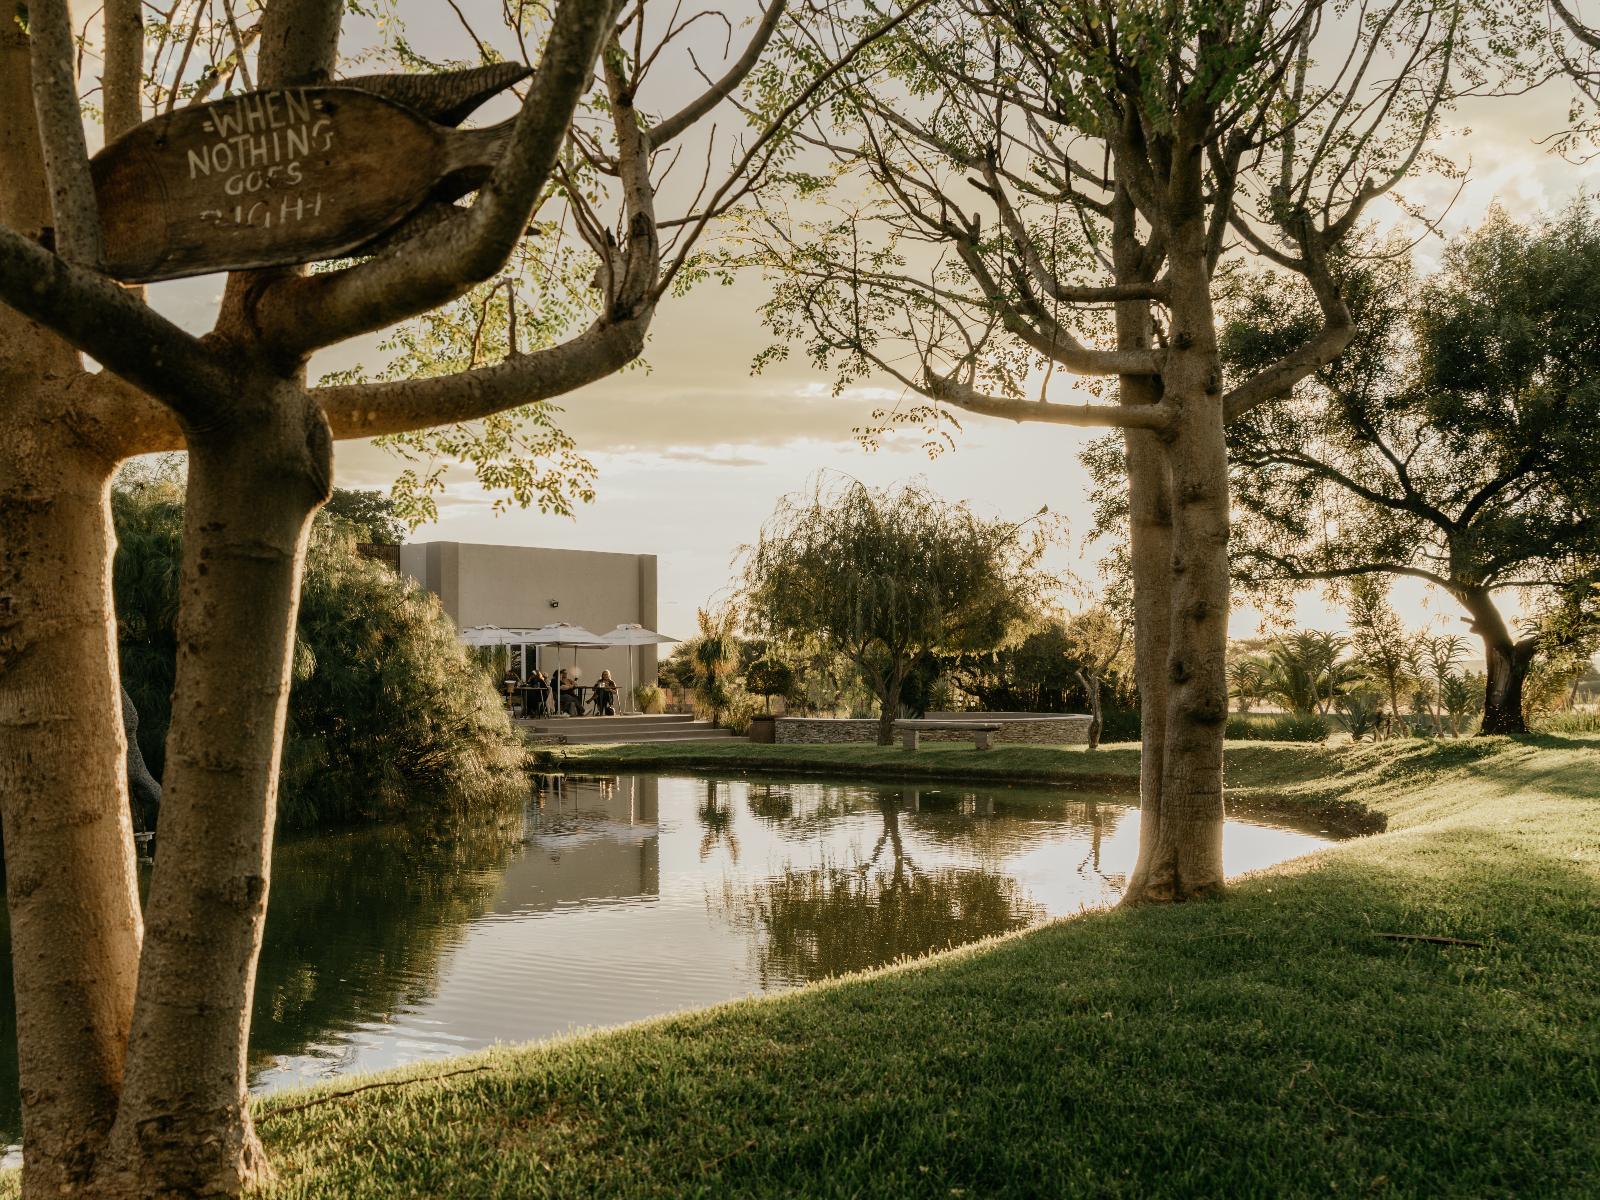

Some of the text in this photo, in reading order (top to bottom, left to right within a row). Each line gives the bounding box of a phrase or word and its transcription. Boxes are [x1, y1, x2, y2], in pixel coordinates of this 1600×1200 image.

[208, 88, 310, 138] WHEN
[187, 119, 334, 179] NOTHING
[224, 161, 303, 195] GOES
